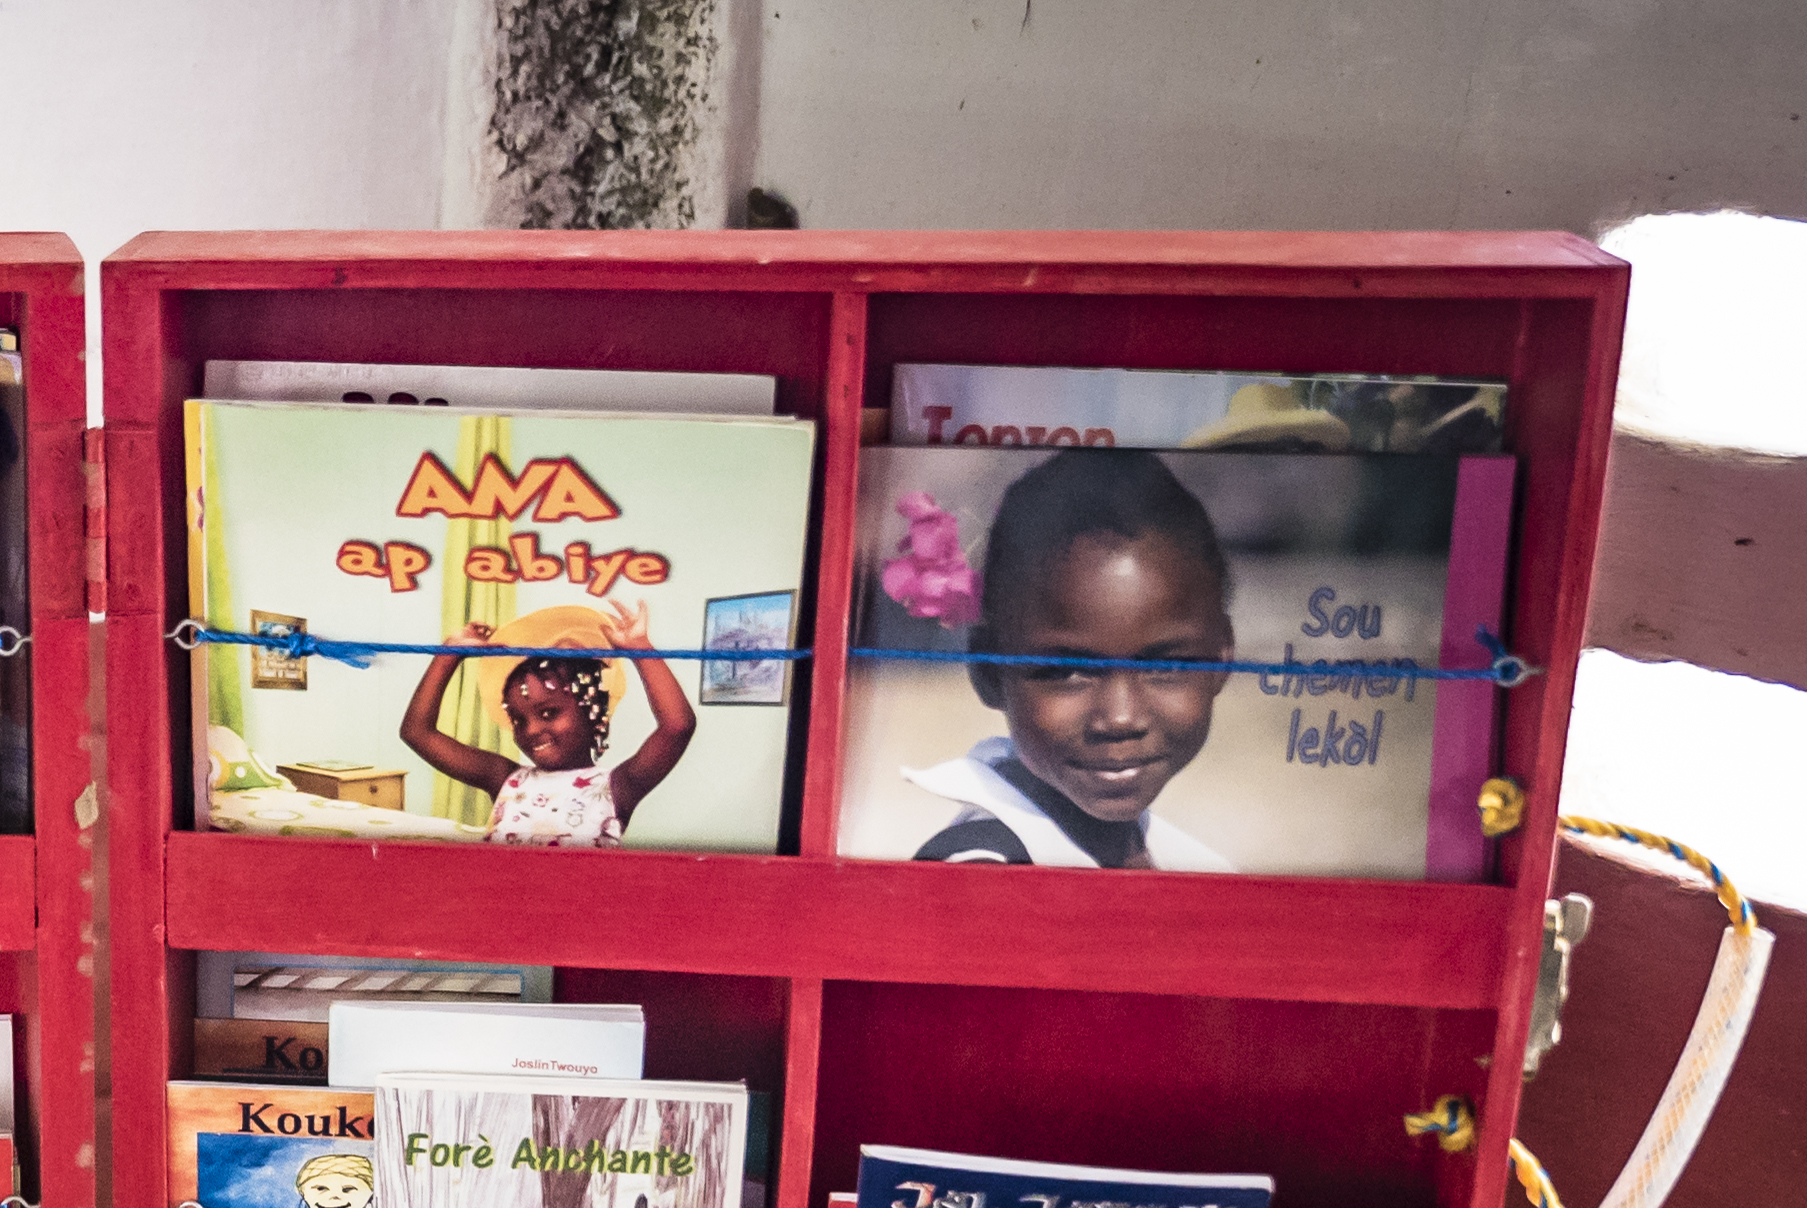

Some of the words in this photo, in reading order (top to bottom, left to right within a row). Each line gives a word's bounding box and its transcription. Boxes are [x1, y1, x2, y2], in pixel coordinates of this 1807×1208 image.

[396, 450, 621, 522] ANA
[336, 539, 432, 593] ap
[464, 533, 670, 597] abiye
[1302, 586, 1382, 640] Sou
[1286, 707, 1385, 768] lekòl
[238, 1101, 375, 1140] Kouk
[405, 1133, 494, 1169] Forè
[511, 1137, 694, 1177] Anchante
